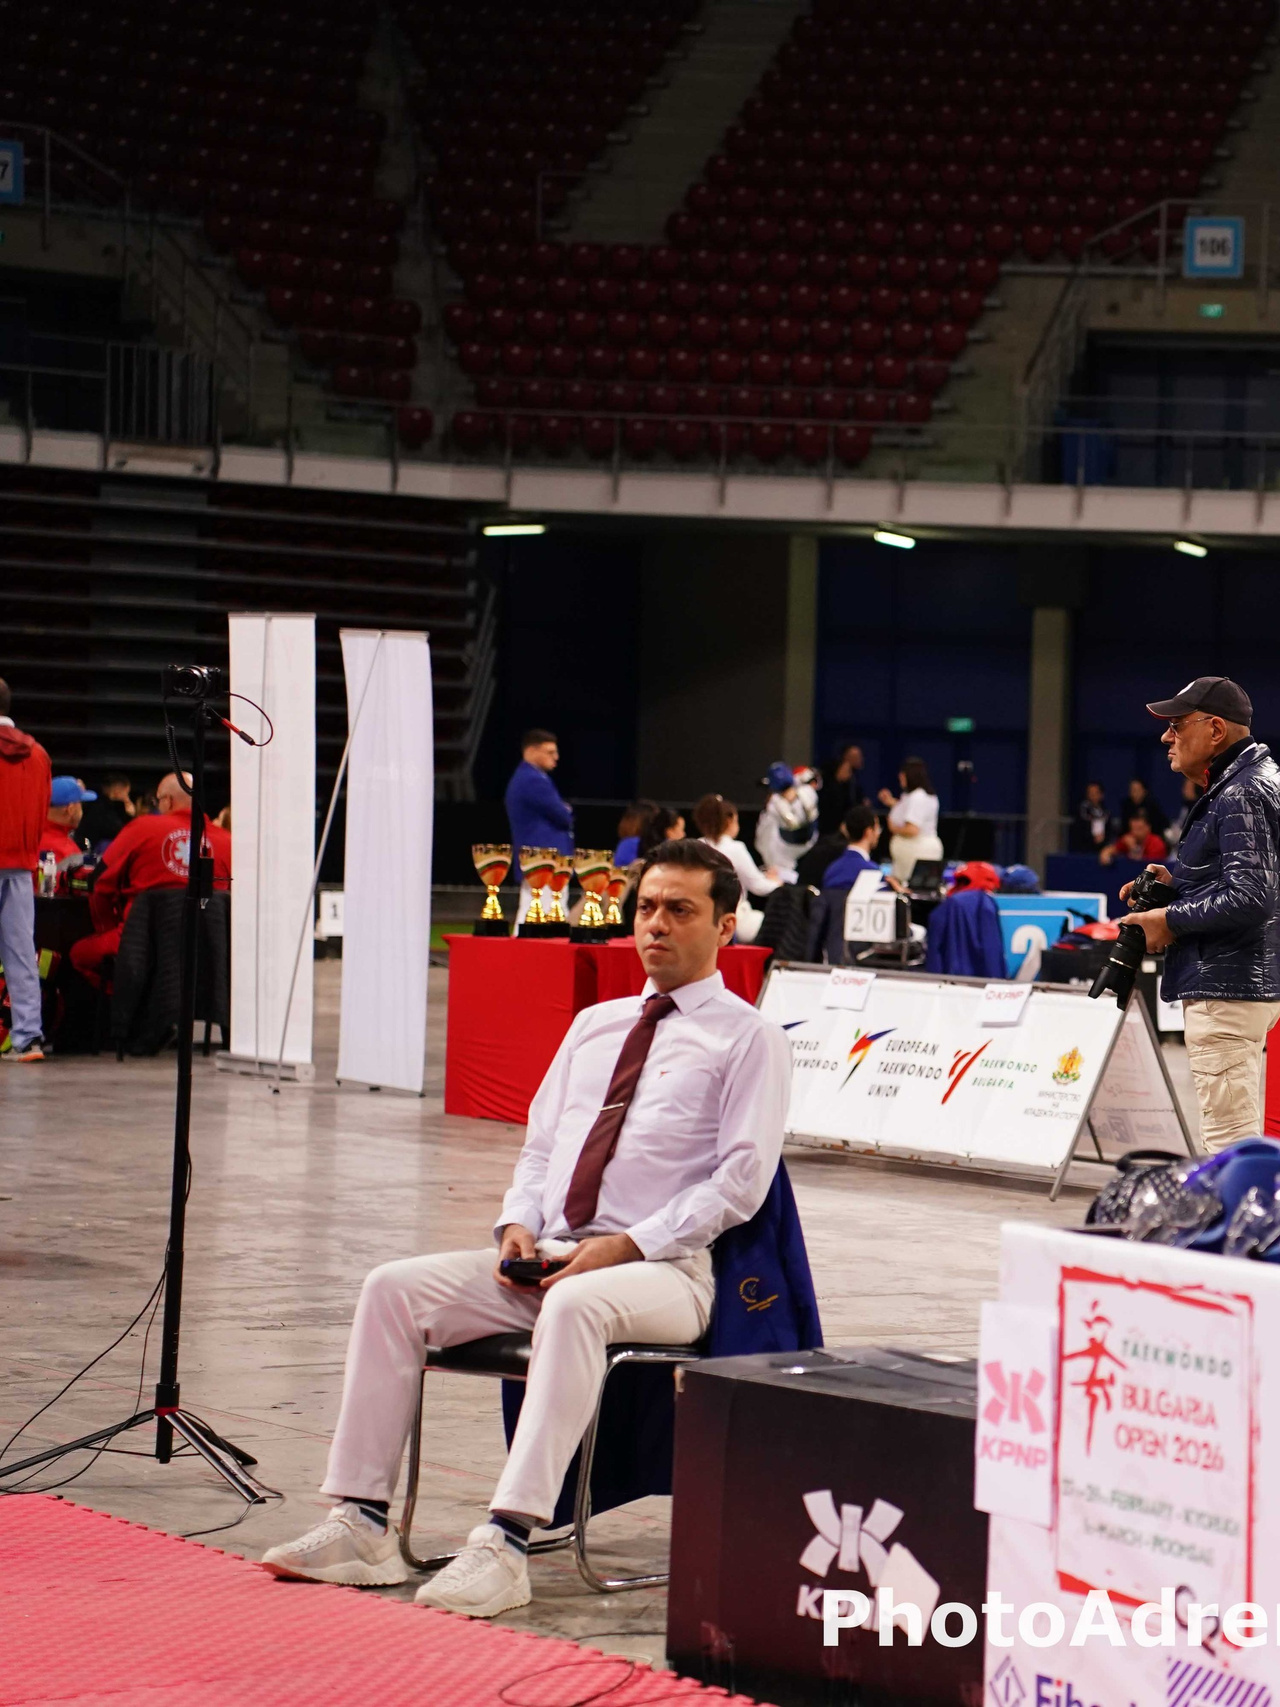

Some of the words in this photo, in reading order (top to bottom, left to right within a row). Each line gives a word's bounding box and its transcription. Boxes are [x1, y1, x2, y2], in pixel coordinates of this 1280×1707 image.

[1199, 236, 1230, 256] 106
[885, 1039, 940, 1056] EUROPEAN
[877, 1061, 943, 1080] TAEKWONDO
[979, 1058, 1039, 1073] TAEKWONDO
[868, 1084, 901, 1097] UNION
[972, 1077, 1015, 1089] BULGARIA
[1121, 1339, 1233, 1378] TAEKWONDO
[1121, 1382, 1219, 1429] BULGARIA
[979, 1435, 1049, 1470] KPNP
[1114, 1422, 1168, 1458] OPEN
[1173, 1434, 1225, 1472] 2026
